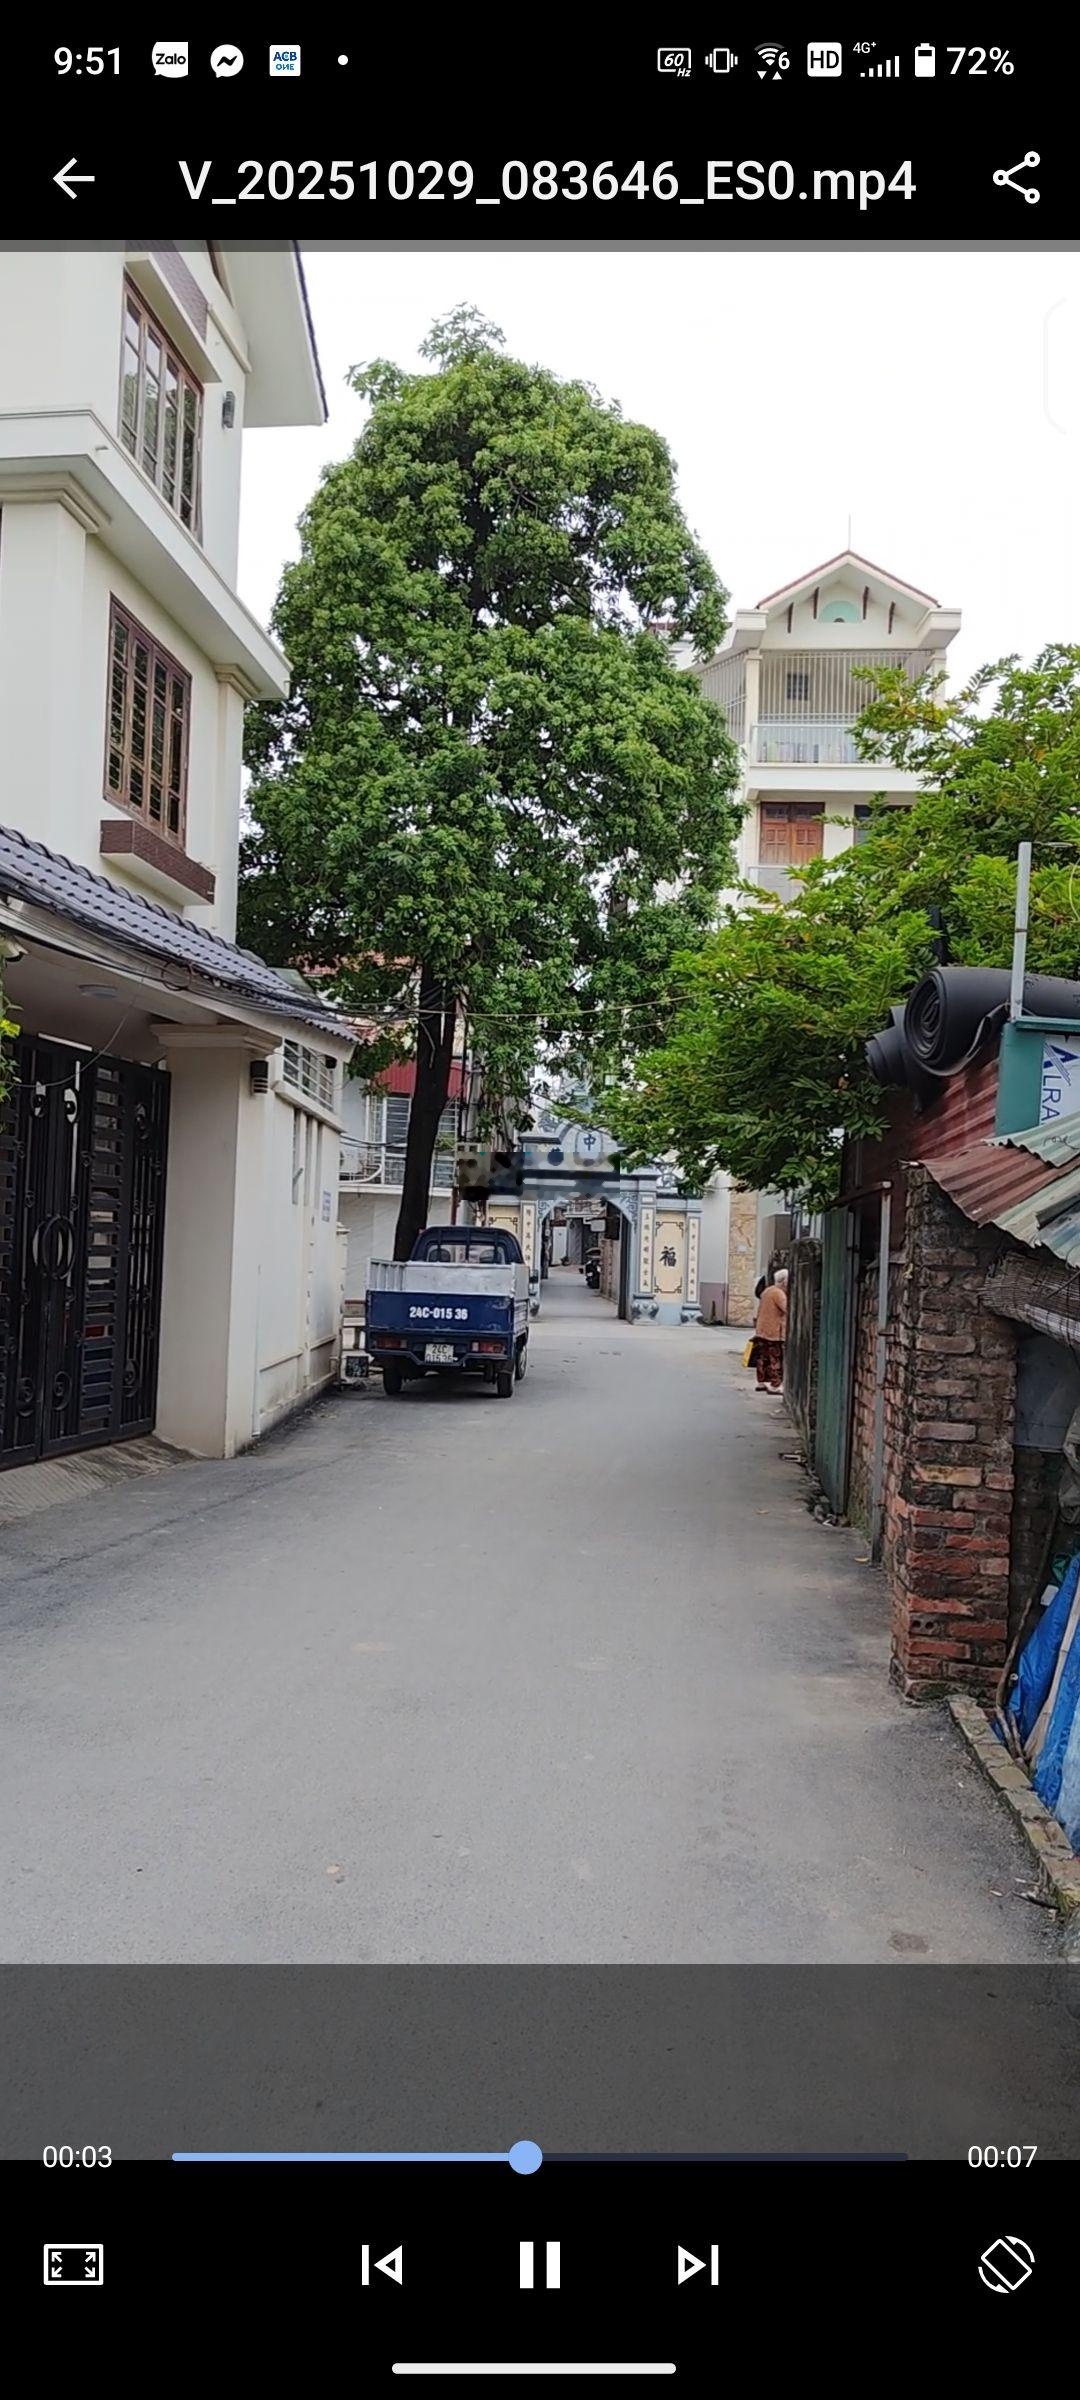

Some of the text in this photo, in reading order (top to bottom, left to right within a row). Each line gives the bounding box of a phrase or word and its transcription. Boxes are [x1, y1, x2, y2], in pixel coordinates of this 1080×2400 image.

[1041, 1043, 1080, 1126] ALRA
[659, 1246, 677, 1267] 福
[409, 1306, 468, 1320] 24C-015 36
[432, 1344, 448, 1354] 24C
